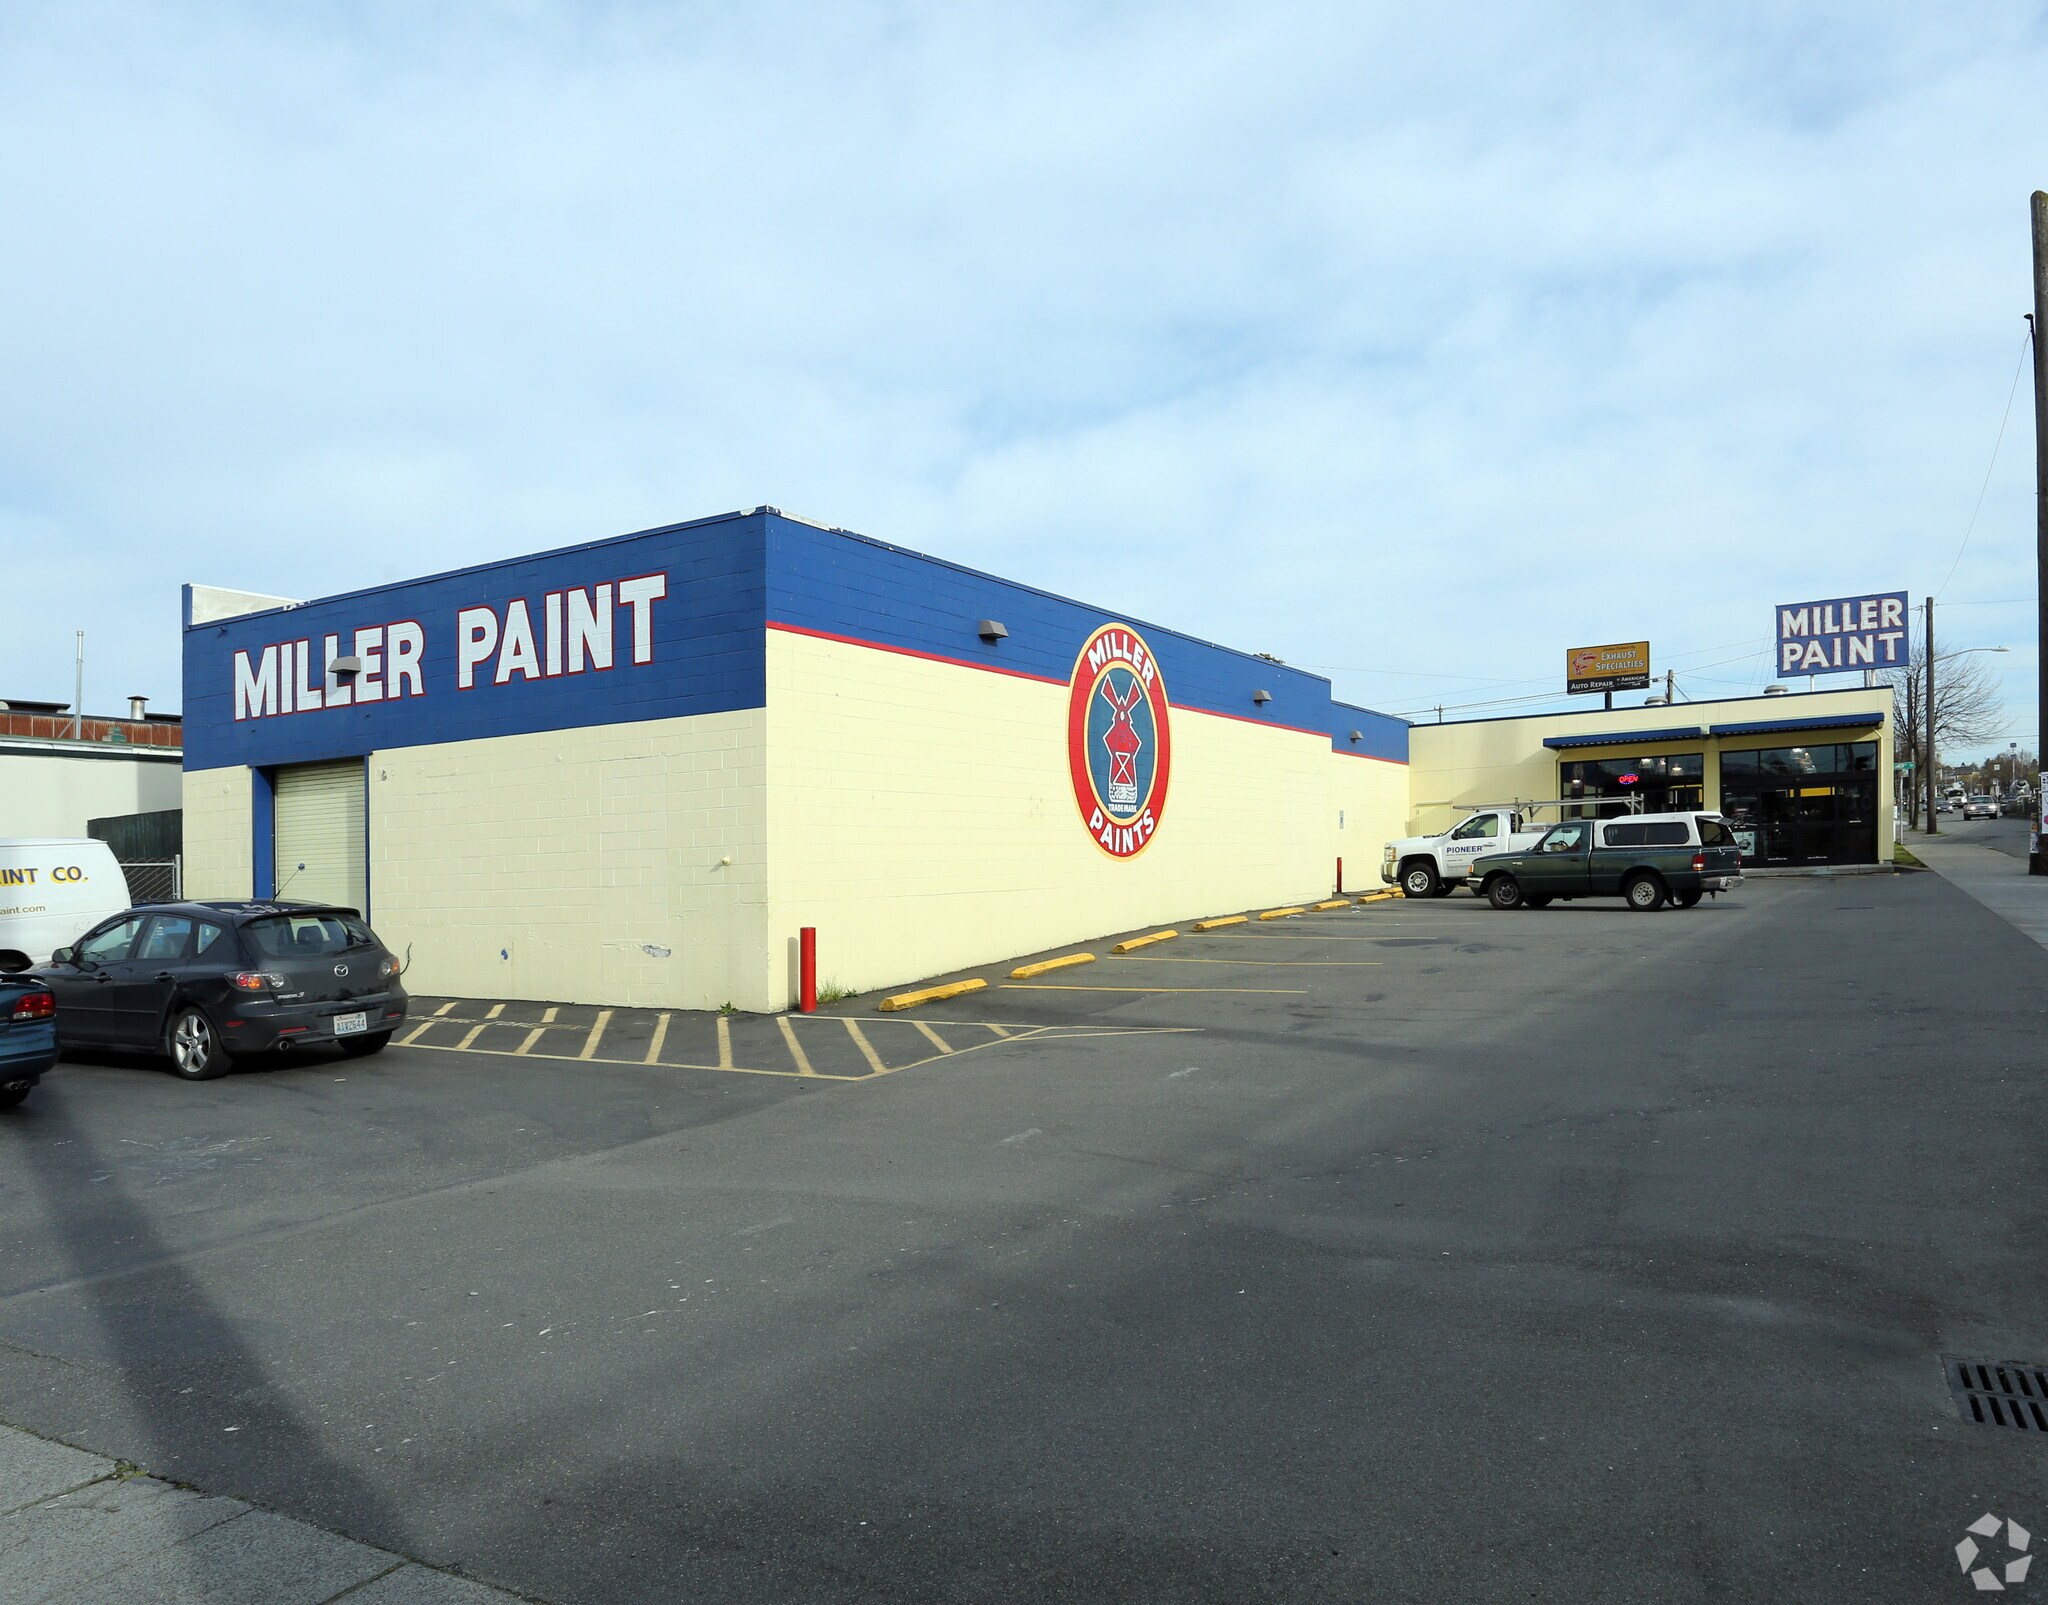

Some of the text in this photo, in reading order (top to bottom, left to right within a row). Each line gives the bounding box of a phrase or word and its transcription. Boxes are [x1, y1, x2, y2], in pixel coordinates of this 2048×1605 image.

[1782, 598, 1904, 639] MILLER
[233, 571, 667, 722] MILLER PAINT
[1601, 650, 1637, 661] EXHAUST
[1782, 631, 1904, 672] PAINT
[1087, 632, 1154, 689] MILLER
[1595, 660, 1644, 671] SPECIALTIES
[1618, 775, 1639, 784] OPEN
[1108, 803, 1138, 813] TRADE MARK
[1089, 806, 1155, 854] PAINTS
[1446, 845, 1483, 854] PIONEER
[0, 865, 89, 886] INT CO.
